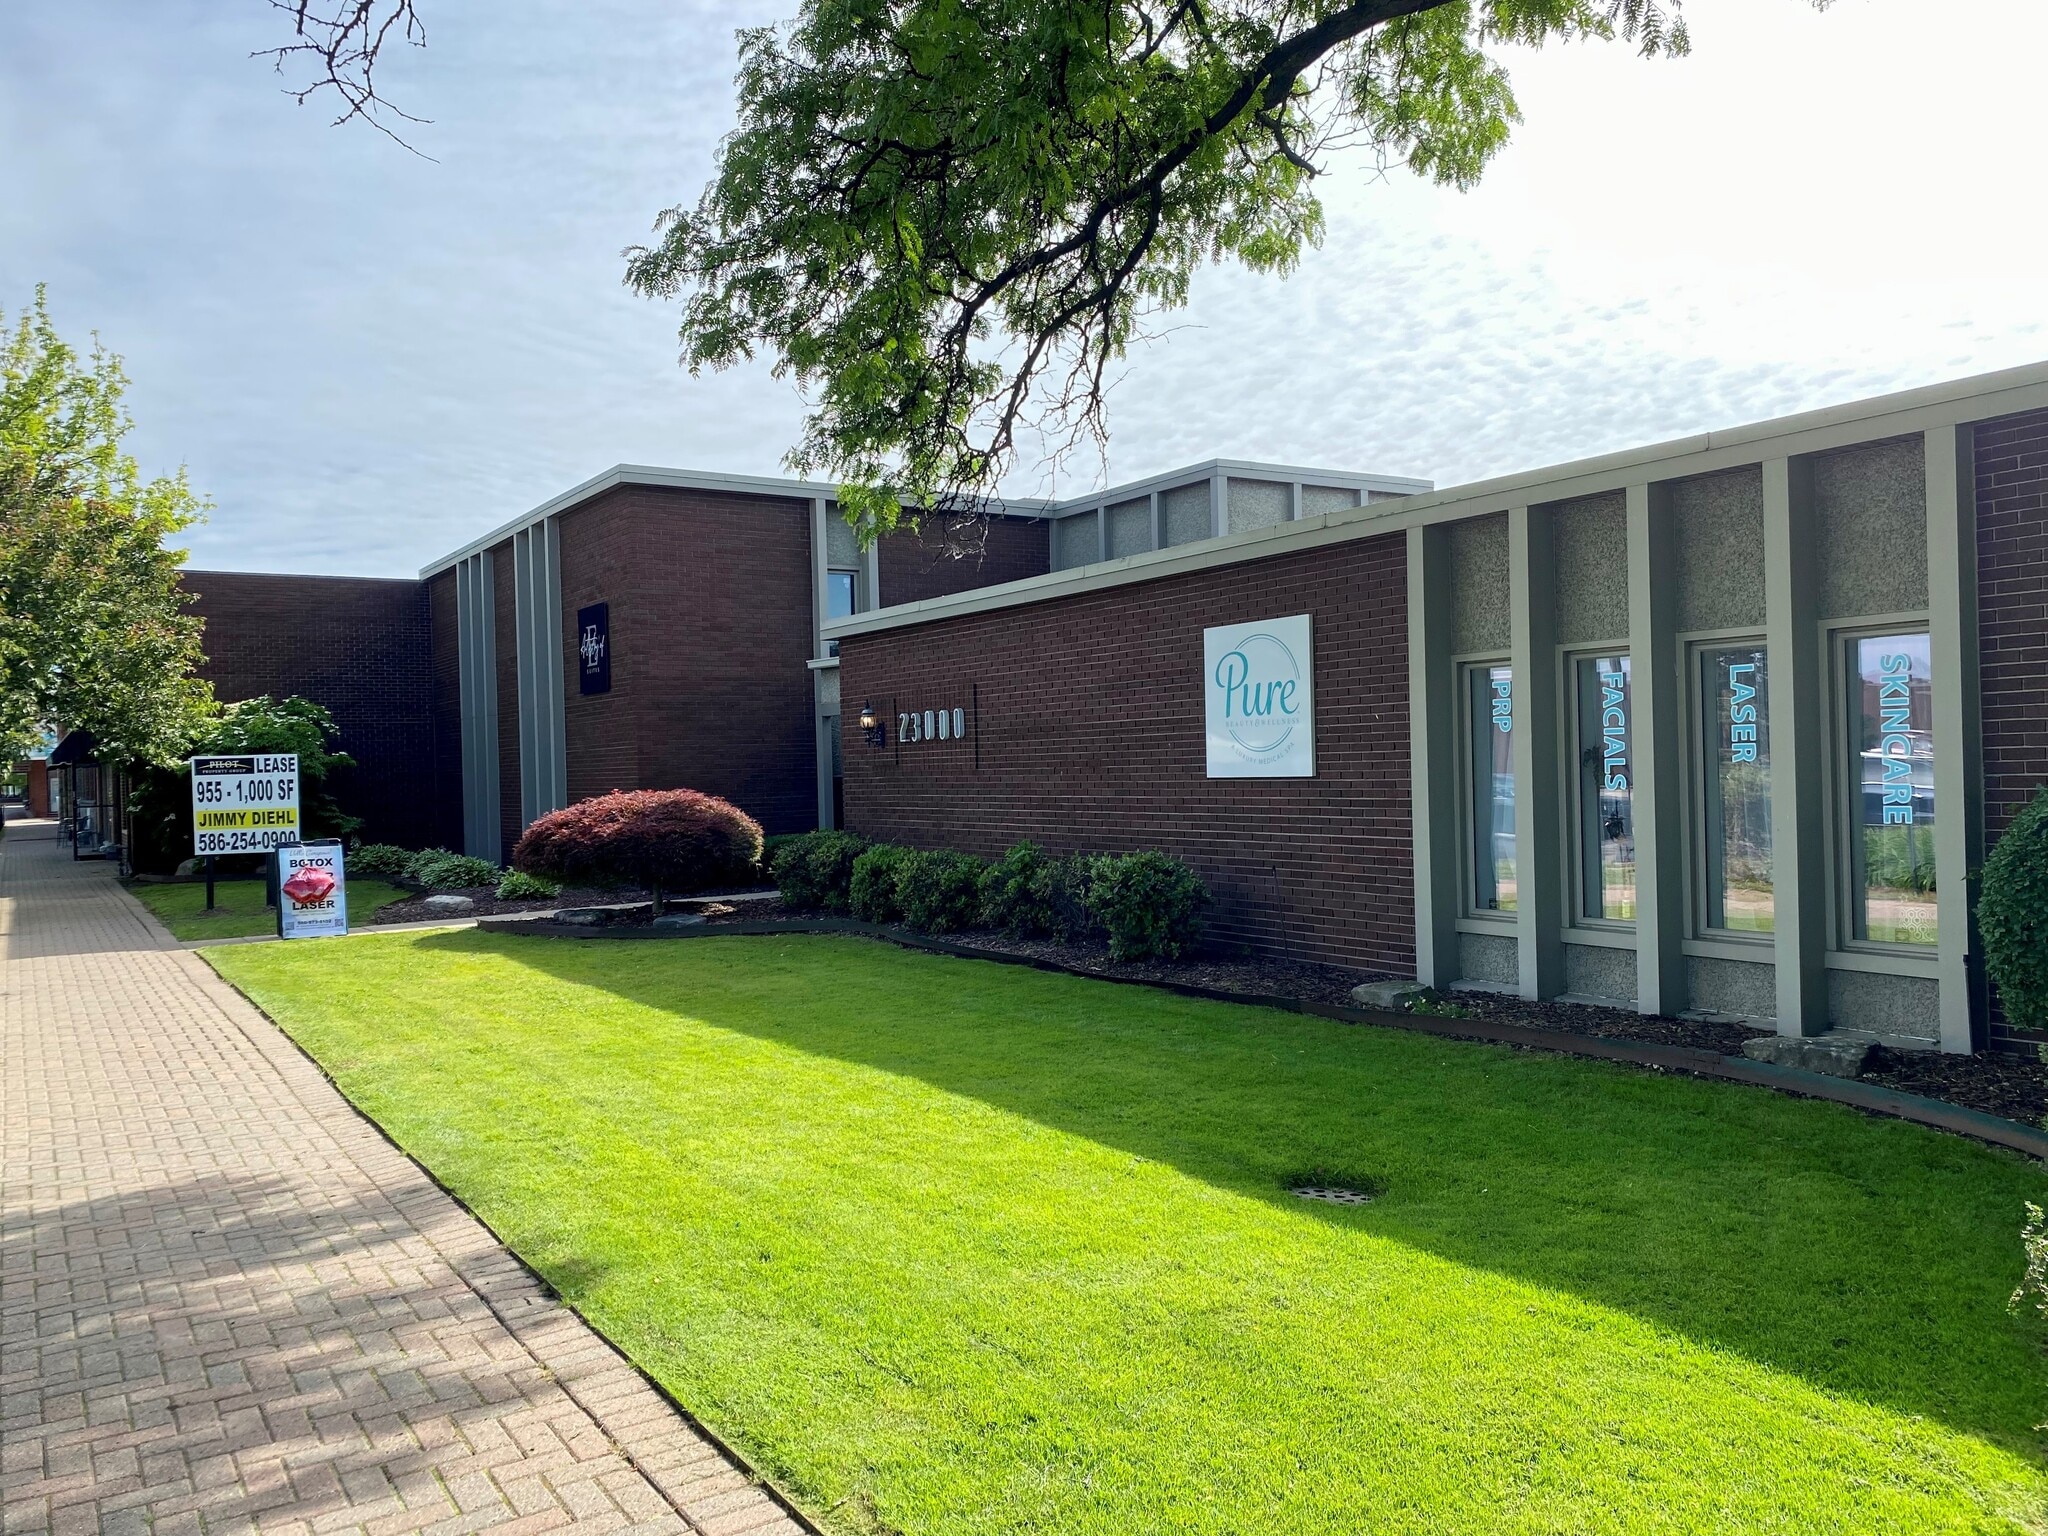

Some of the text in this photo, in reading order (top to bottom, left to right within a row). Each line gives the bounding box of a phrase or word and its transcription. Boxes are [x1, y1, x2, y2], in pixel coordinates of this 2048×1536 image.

[1215, 651, 1300, 718] Pure
[1492, 680, 1512, 733] PRP
[1729, 663, 1757, 763] LASER
[899, 707, 966, 742] 23000
[1602, 672, 1627, 791] FACIALS
[1880, 653, 1913, 825] SKINCARE
[209, 760, 240, 769] PILOT
[256, 757, 296, 773] LEASE
[1258, 752, 1284, 765] MEDICAL
[197, 781, 222, 803] 955
[236, 779, 273, 804] 1,000
[278, 779, 294, 801] SF
[199, 811, 295, 827] JIMMY DIEHL
[290, 858, 333, 868] BOTOX
[292, 900, 336, 910] LASER
